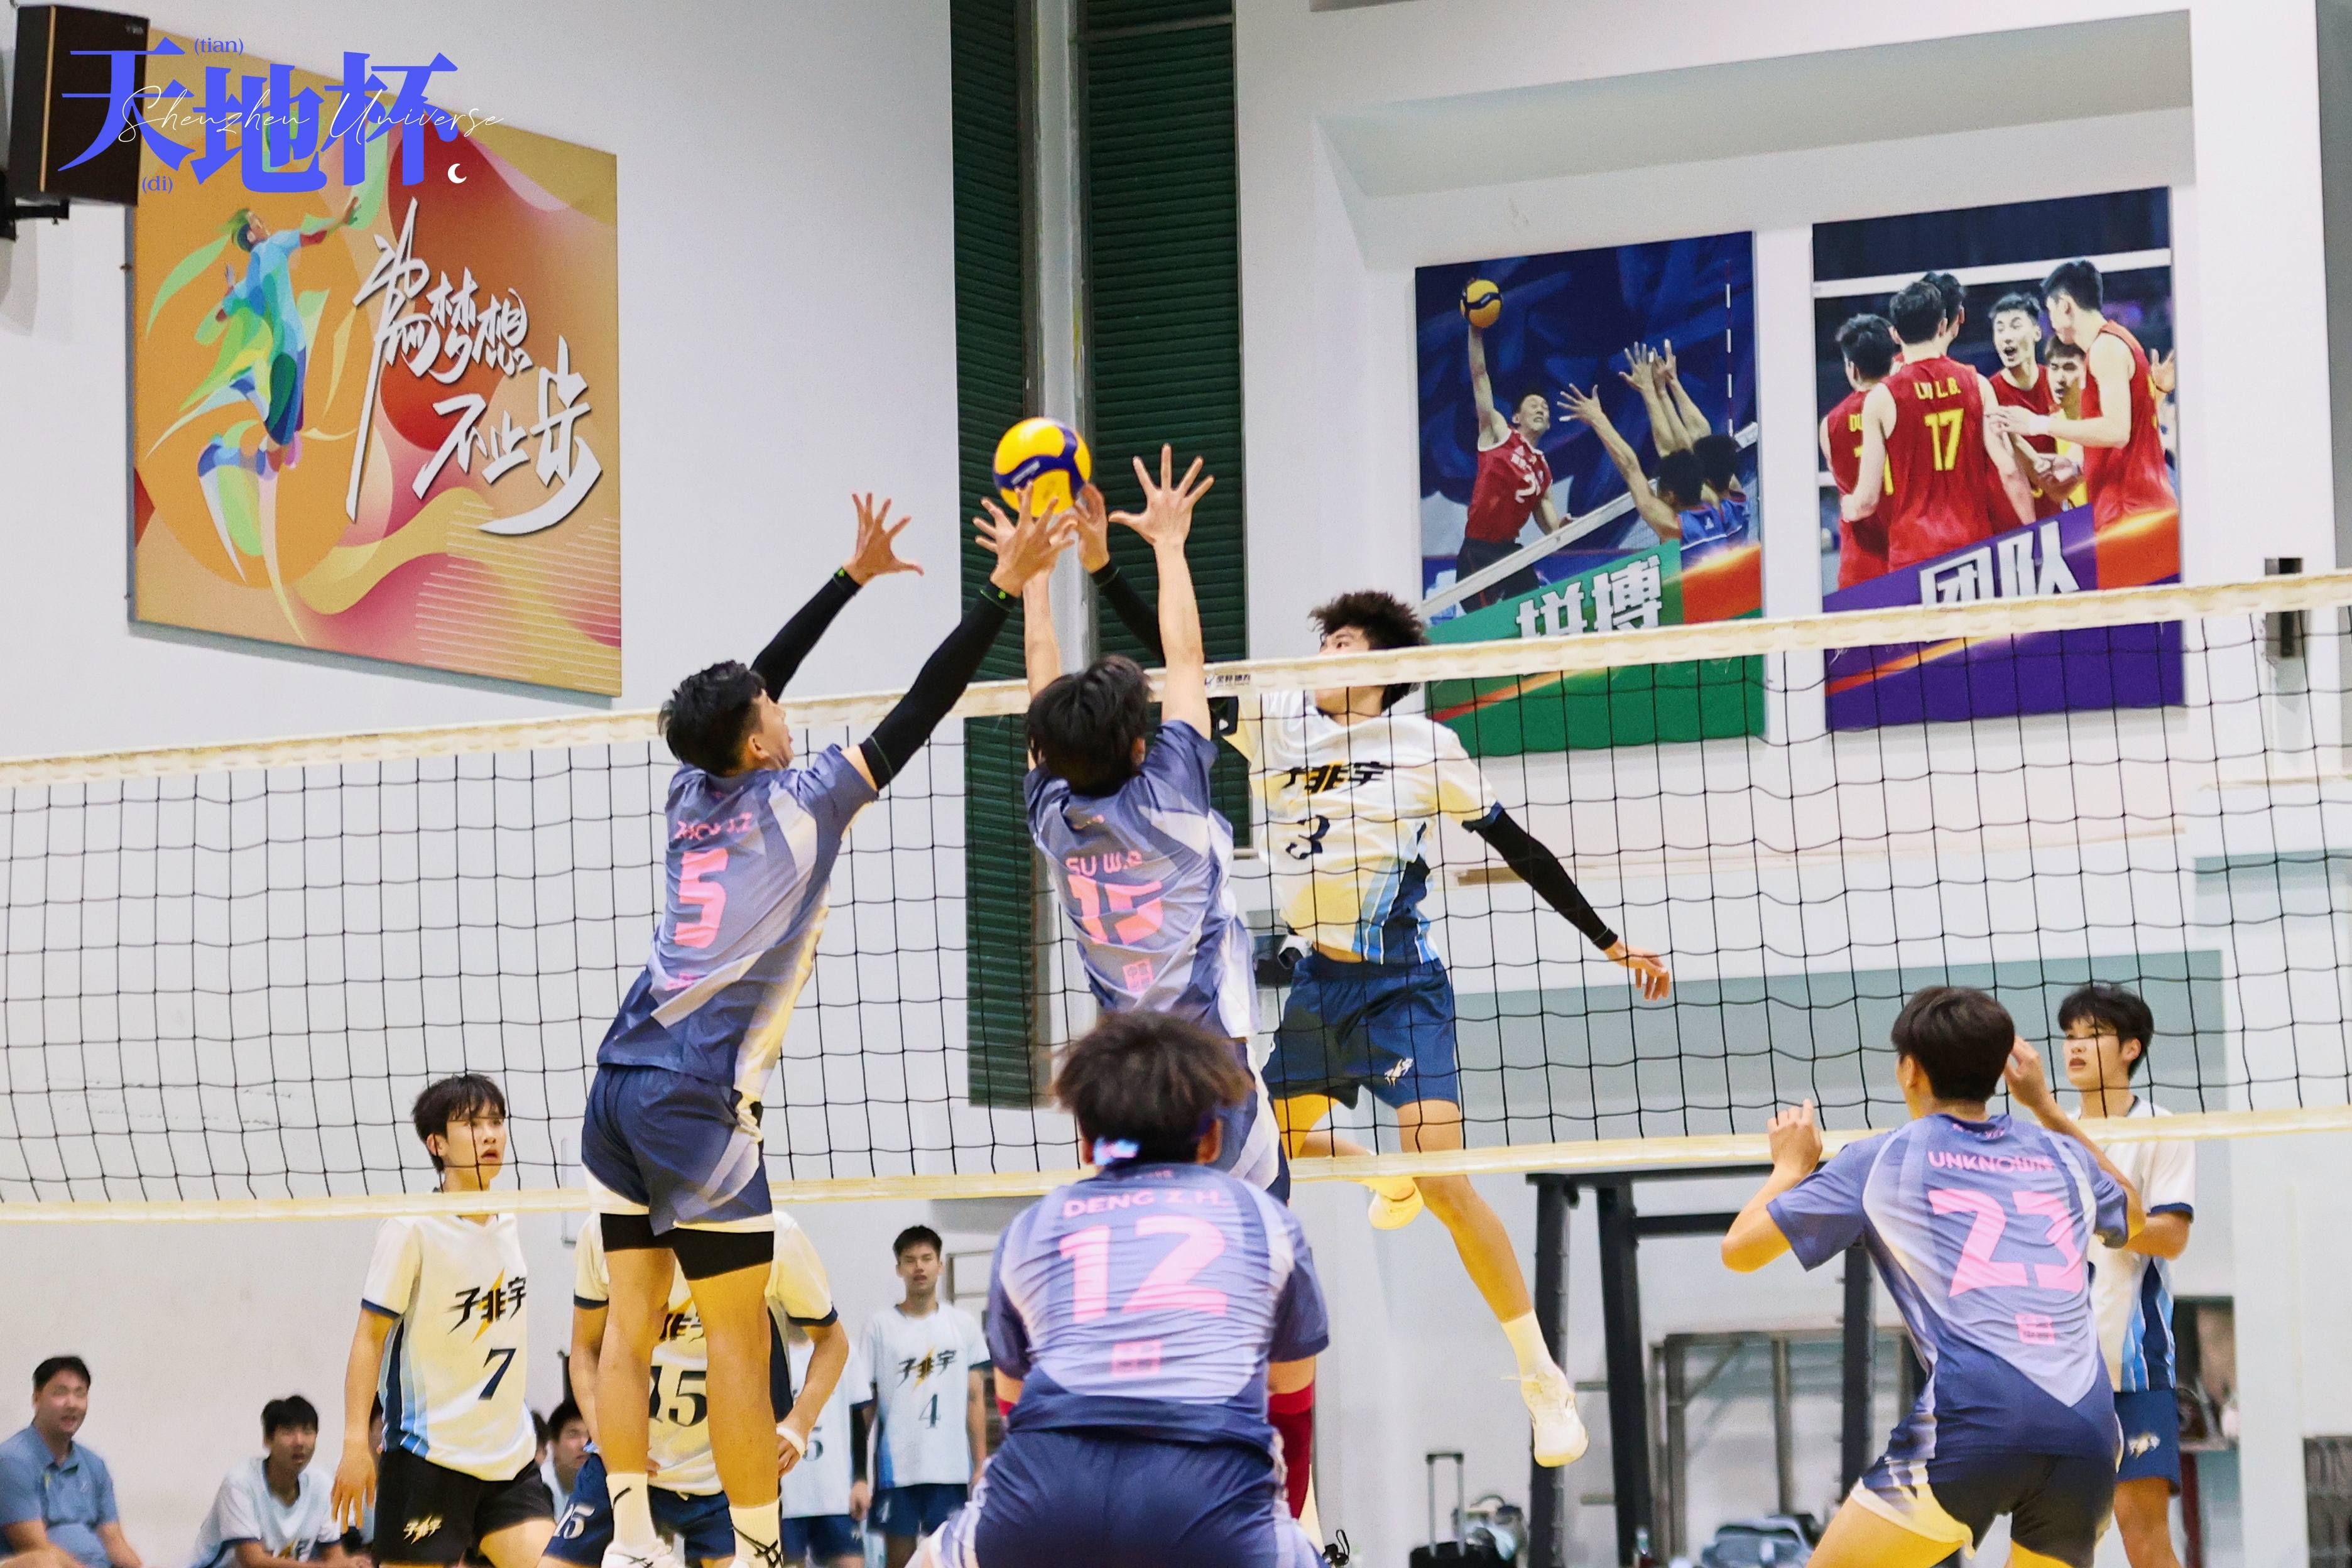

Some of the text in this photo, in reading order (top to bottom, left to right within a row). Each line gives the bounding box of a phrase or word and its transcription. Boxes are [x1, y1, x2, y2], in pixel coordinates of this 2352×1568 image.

[1924, 408, 1964, 471] 17
[1065, 856, 1097, 876] SU
[674, 848, 729, 949] 5
[1067, 874, 1164, 945] 15
[1062, 1189, 1155, 1219] DENG
[1059, 1214, 1228, 1323] 12
[1927, 1188, 2084, 1298] 23
[479, 1348, 516, 1401] 7
[648, 1365, 708, 1428] 15
[918, 1393, 941, 1429] 4
